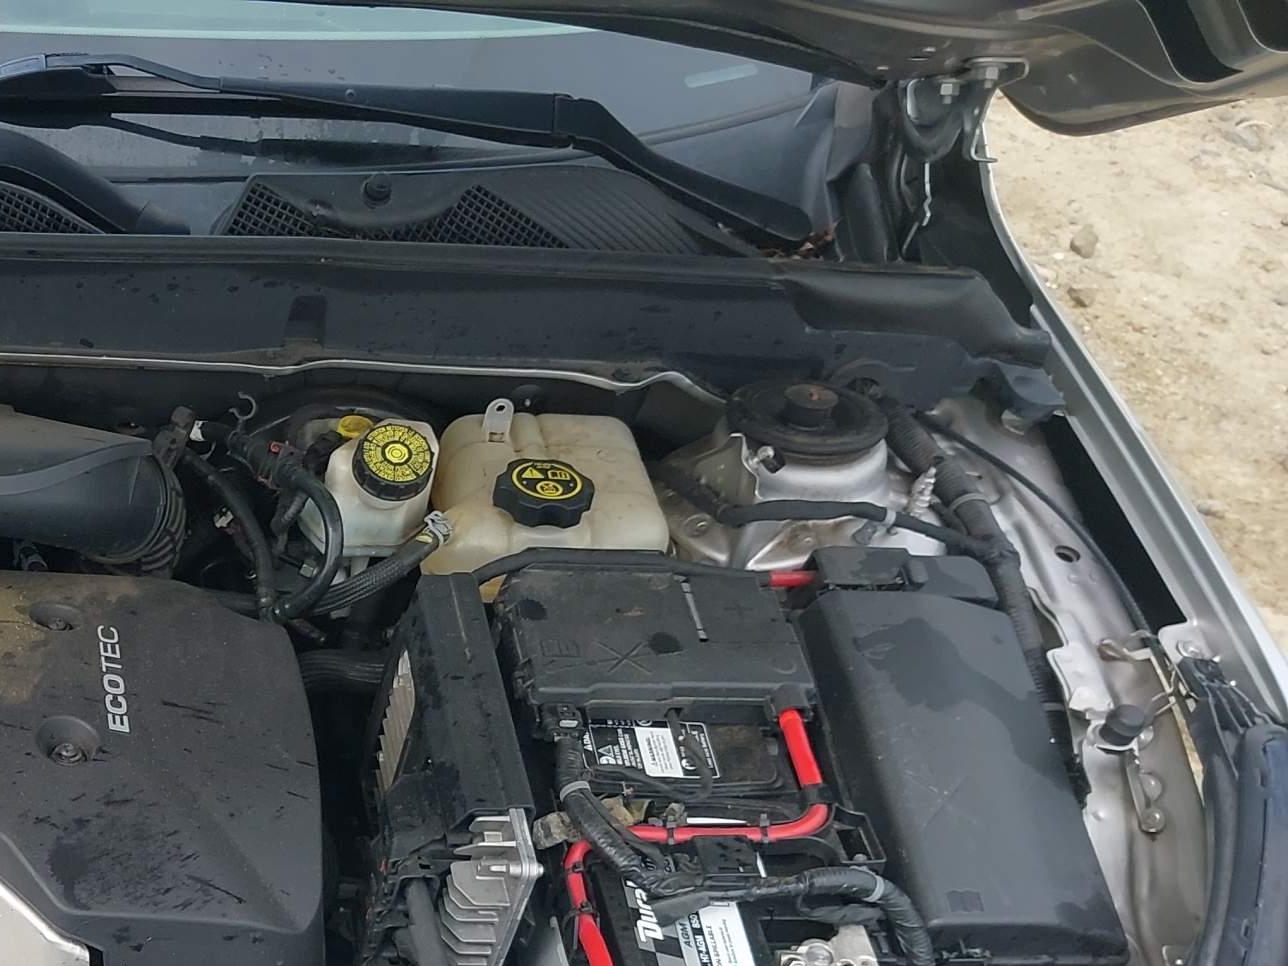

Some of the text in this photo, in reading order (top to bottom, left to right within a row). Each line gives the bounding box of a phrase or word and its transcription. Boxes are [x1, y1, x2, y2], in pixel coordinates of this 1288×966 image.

[97, 625, 130, 733] ECOTEC
[689, 913, 701, 929] 850
[679, 922, 693, 949] AGM
